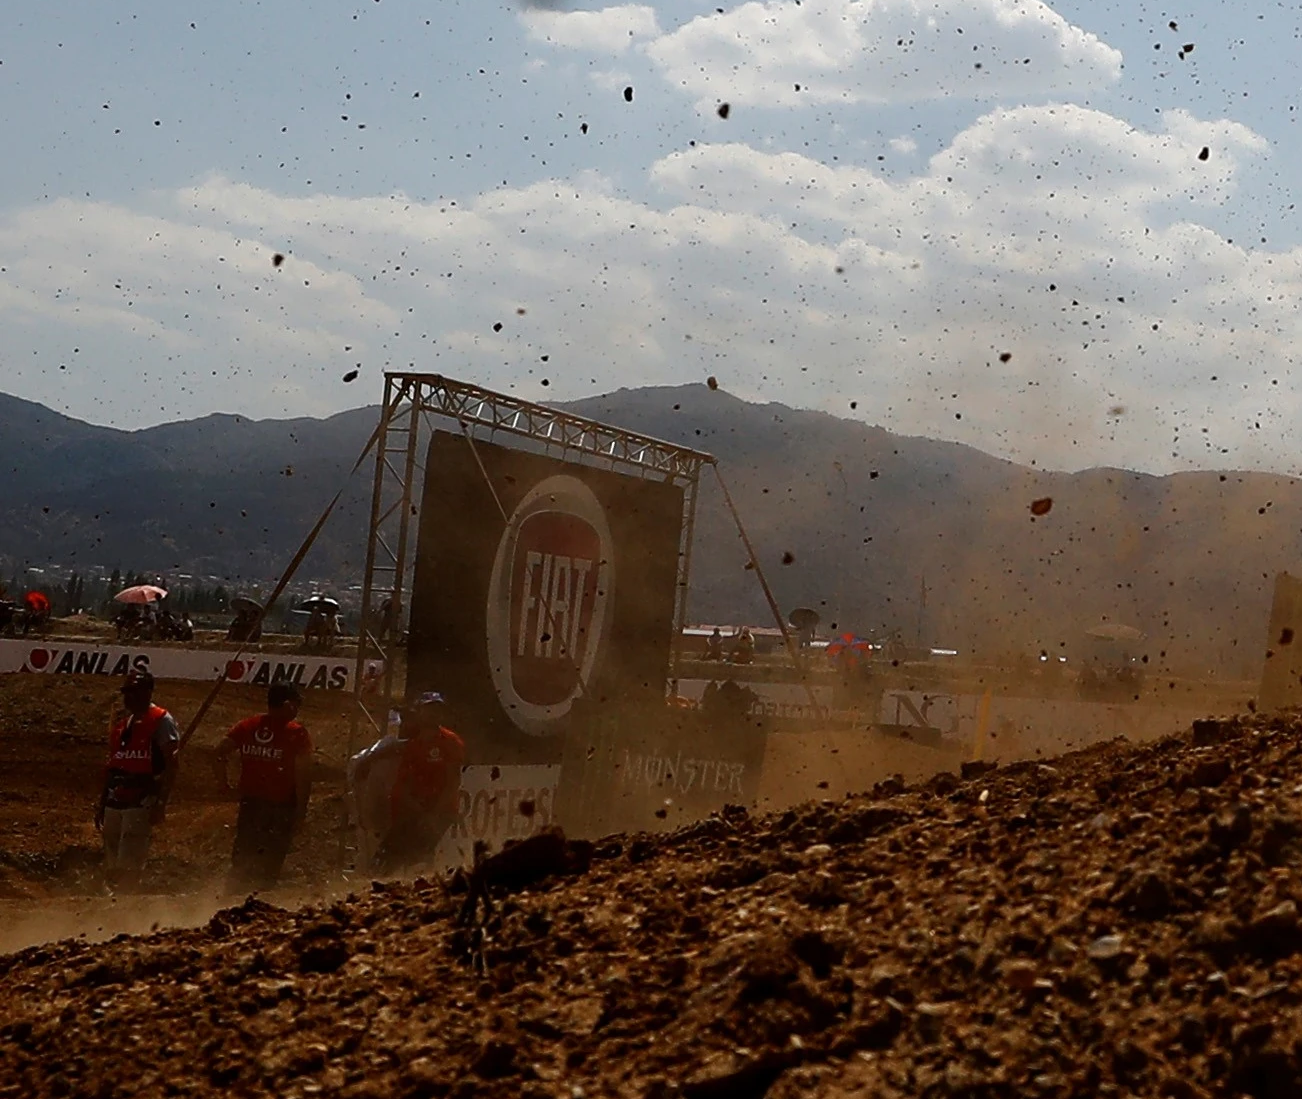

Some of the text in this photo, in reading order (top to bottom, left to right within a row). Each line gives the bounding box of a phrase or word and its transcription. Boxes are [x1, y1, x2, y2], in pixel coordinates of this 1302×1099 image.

[517, 550, 594, 659] FIAT
[54, 649, 151, 676] ANLAS
[251, 661, 348, 690] ANLAS
[242, 744, 283, 759] UMKE
[622, 748, 746, 795] MONSTER
